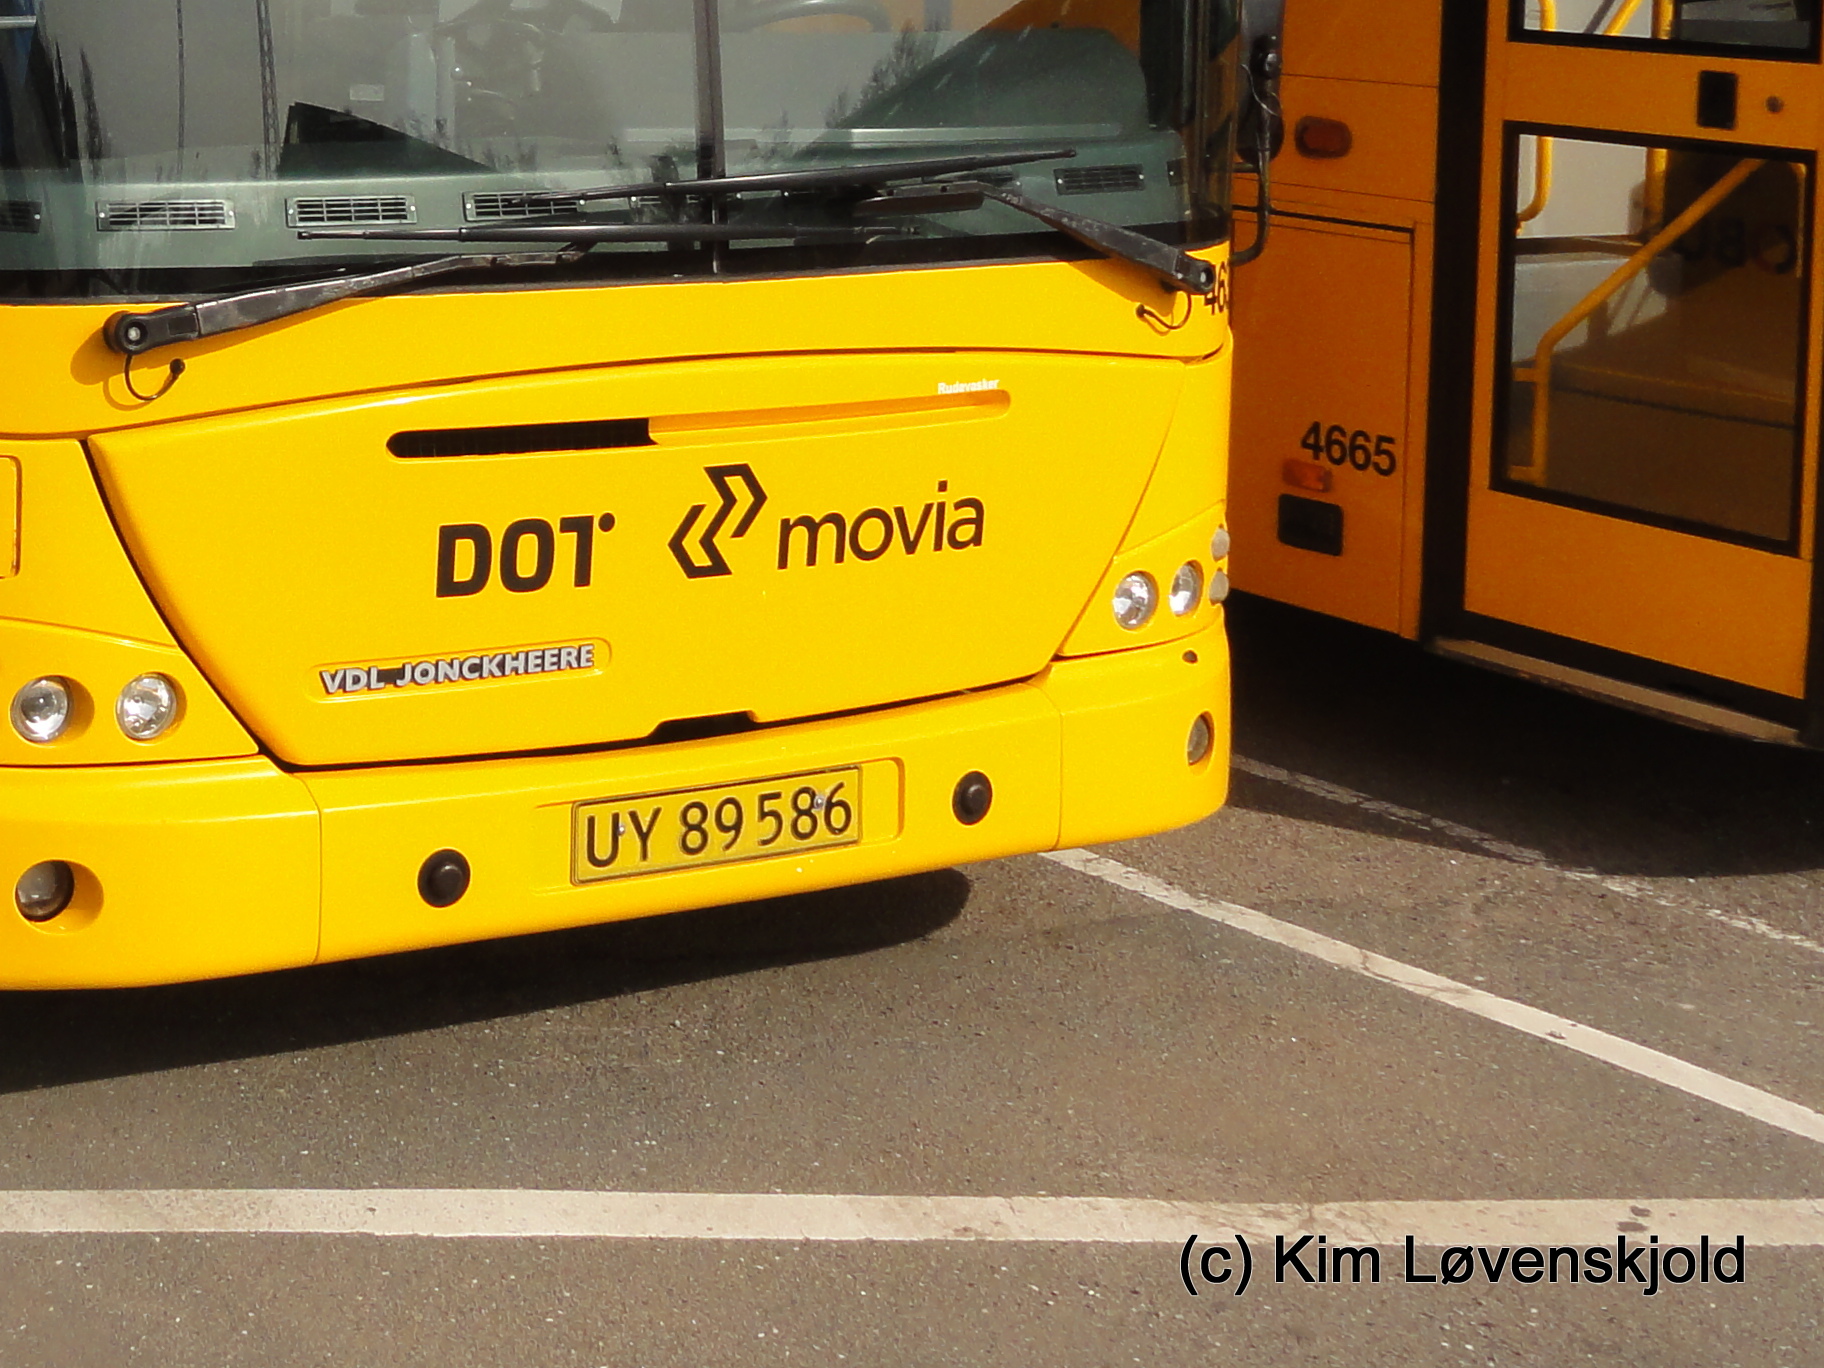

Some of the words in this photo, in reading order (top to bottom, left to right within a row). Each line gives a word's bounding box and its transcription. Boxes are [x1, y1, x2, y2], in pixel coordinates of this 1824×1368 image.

[1300, 420, 1396, 477] 4665
[435, 512, 616, 599] DOT
[776, 479, 986, 571] movia
[320, 667, 385, 695] VDL
[394, 643, 595, 687] JONCKHEERE
[585, 806, 663, 869] UY
